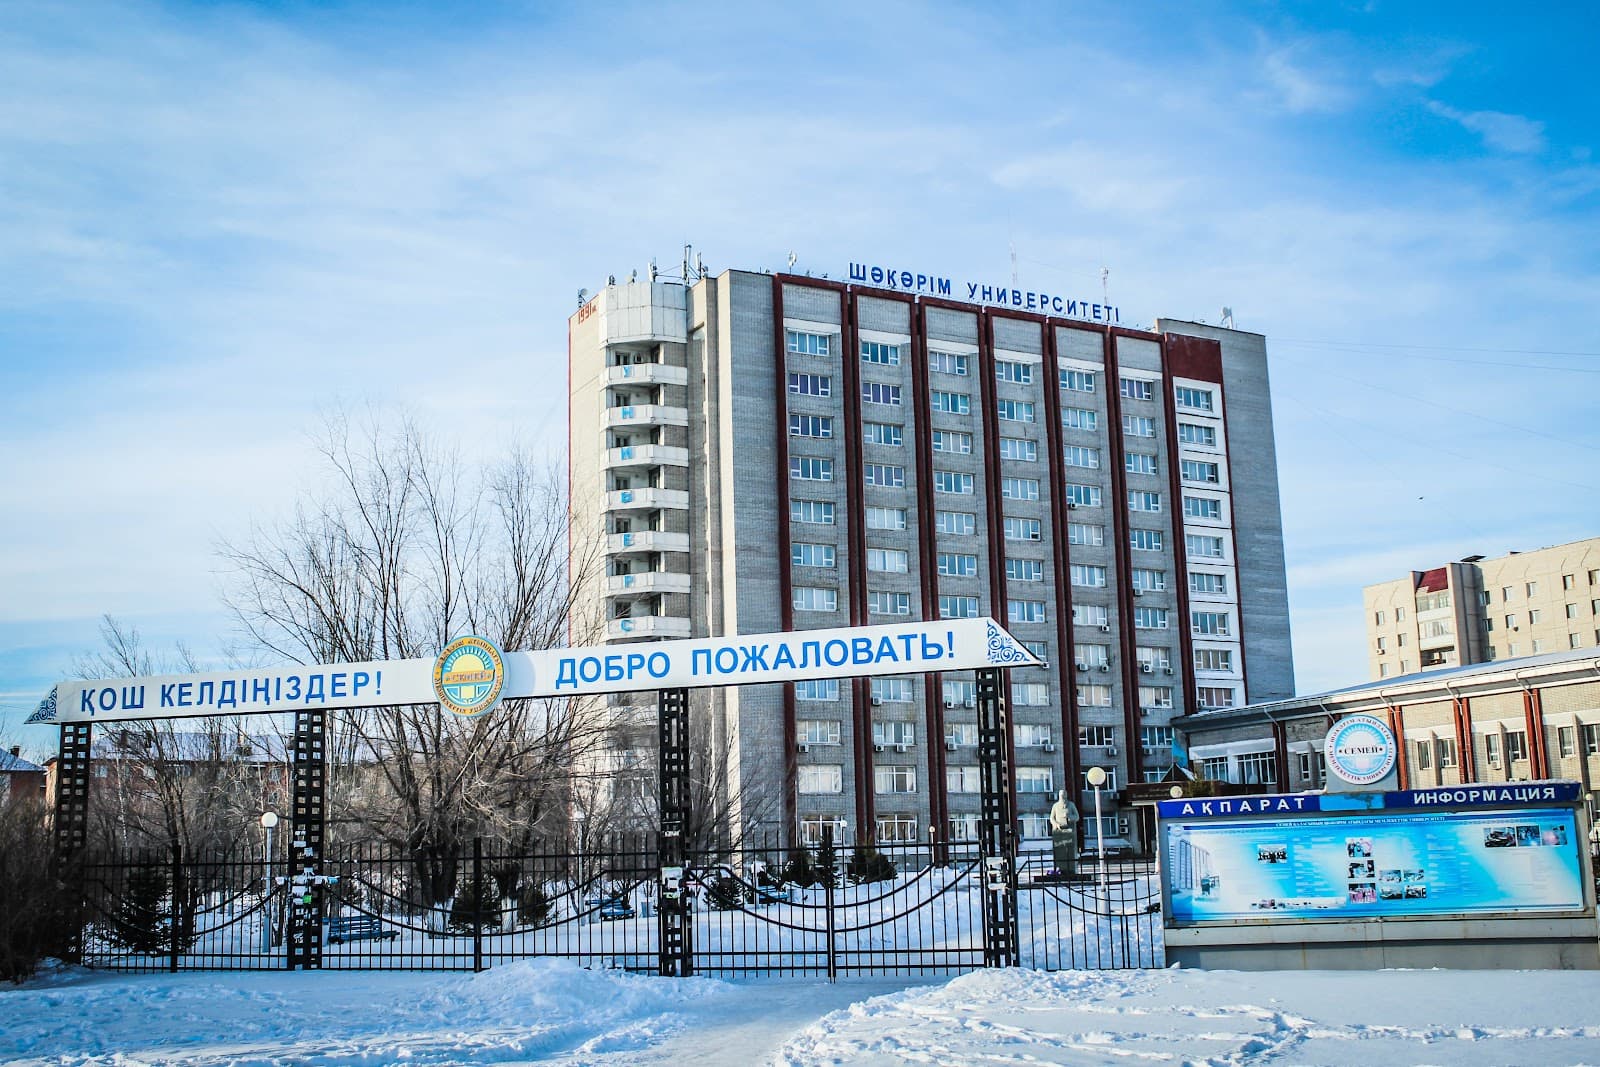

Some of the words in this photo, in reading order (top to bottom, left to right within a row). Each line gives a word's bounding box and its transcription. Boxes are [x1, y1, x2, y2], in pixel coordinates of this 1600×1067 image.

[849, 262, 951, 295] ШӘКӘРІМ
[967, 282, 1119, 322] УНИВЕРСИТЕТІ
[555, 651, 670, 689] ДОБРО
[691, 631, 955, 676] ПОЖАЛОВАТЬ!
[81, 685, 145, 716] ҚОШ
[160, 671, 382, 709] КЕЛДІҢІЗДЕР!
[1344, 745, 1378, 755] СЕМЕЙ
[1182, 797, 1305, 816] АҚПАРАТ
[1413, 787, 1556, 806] ИНФОРМАЦИЯ
